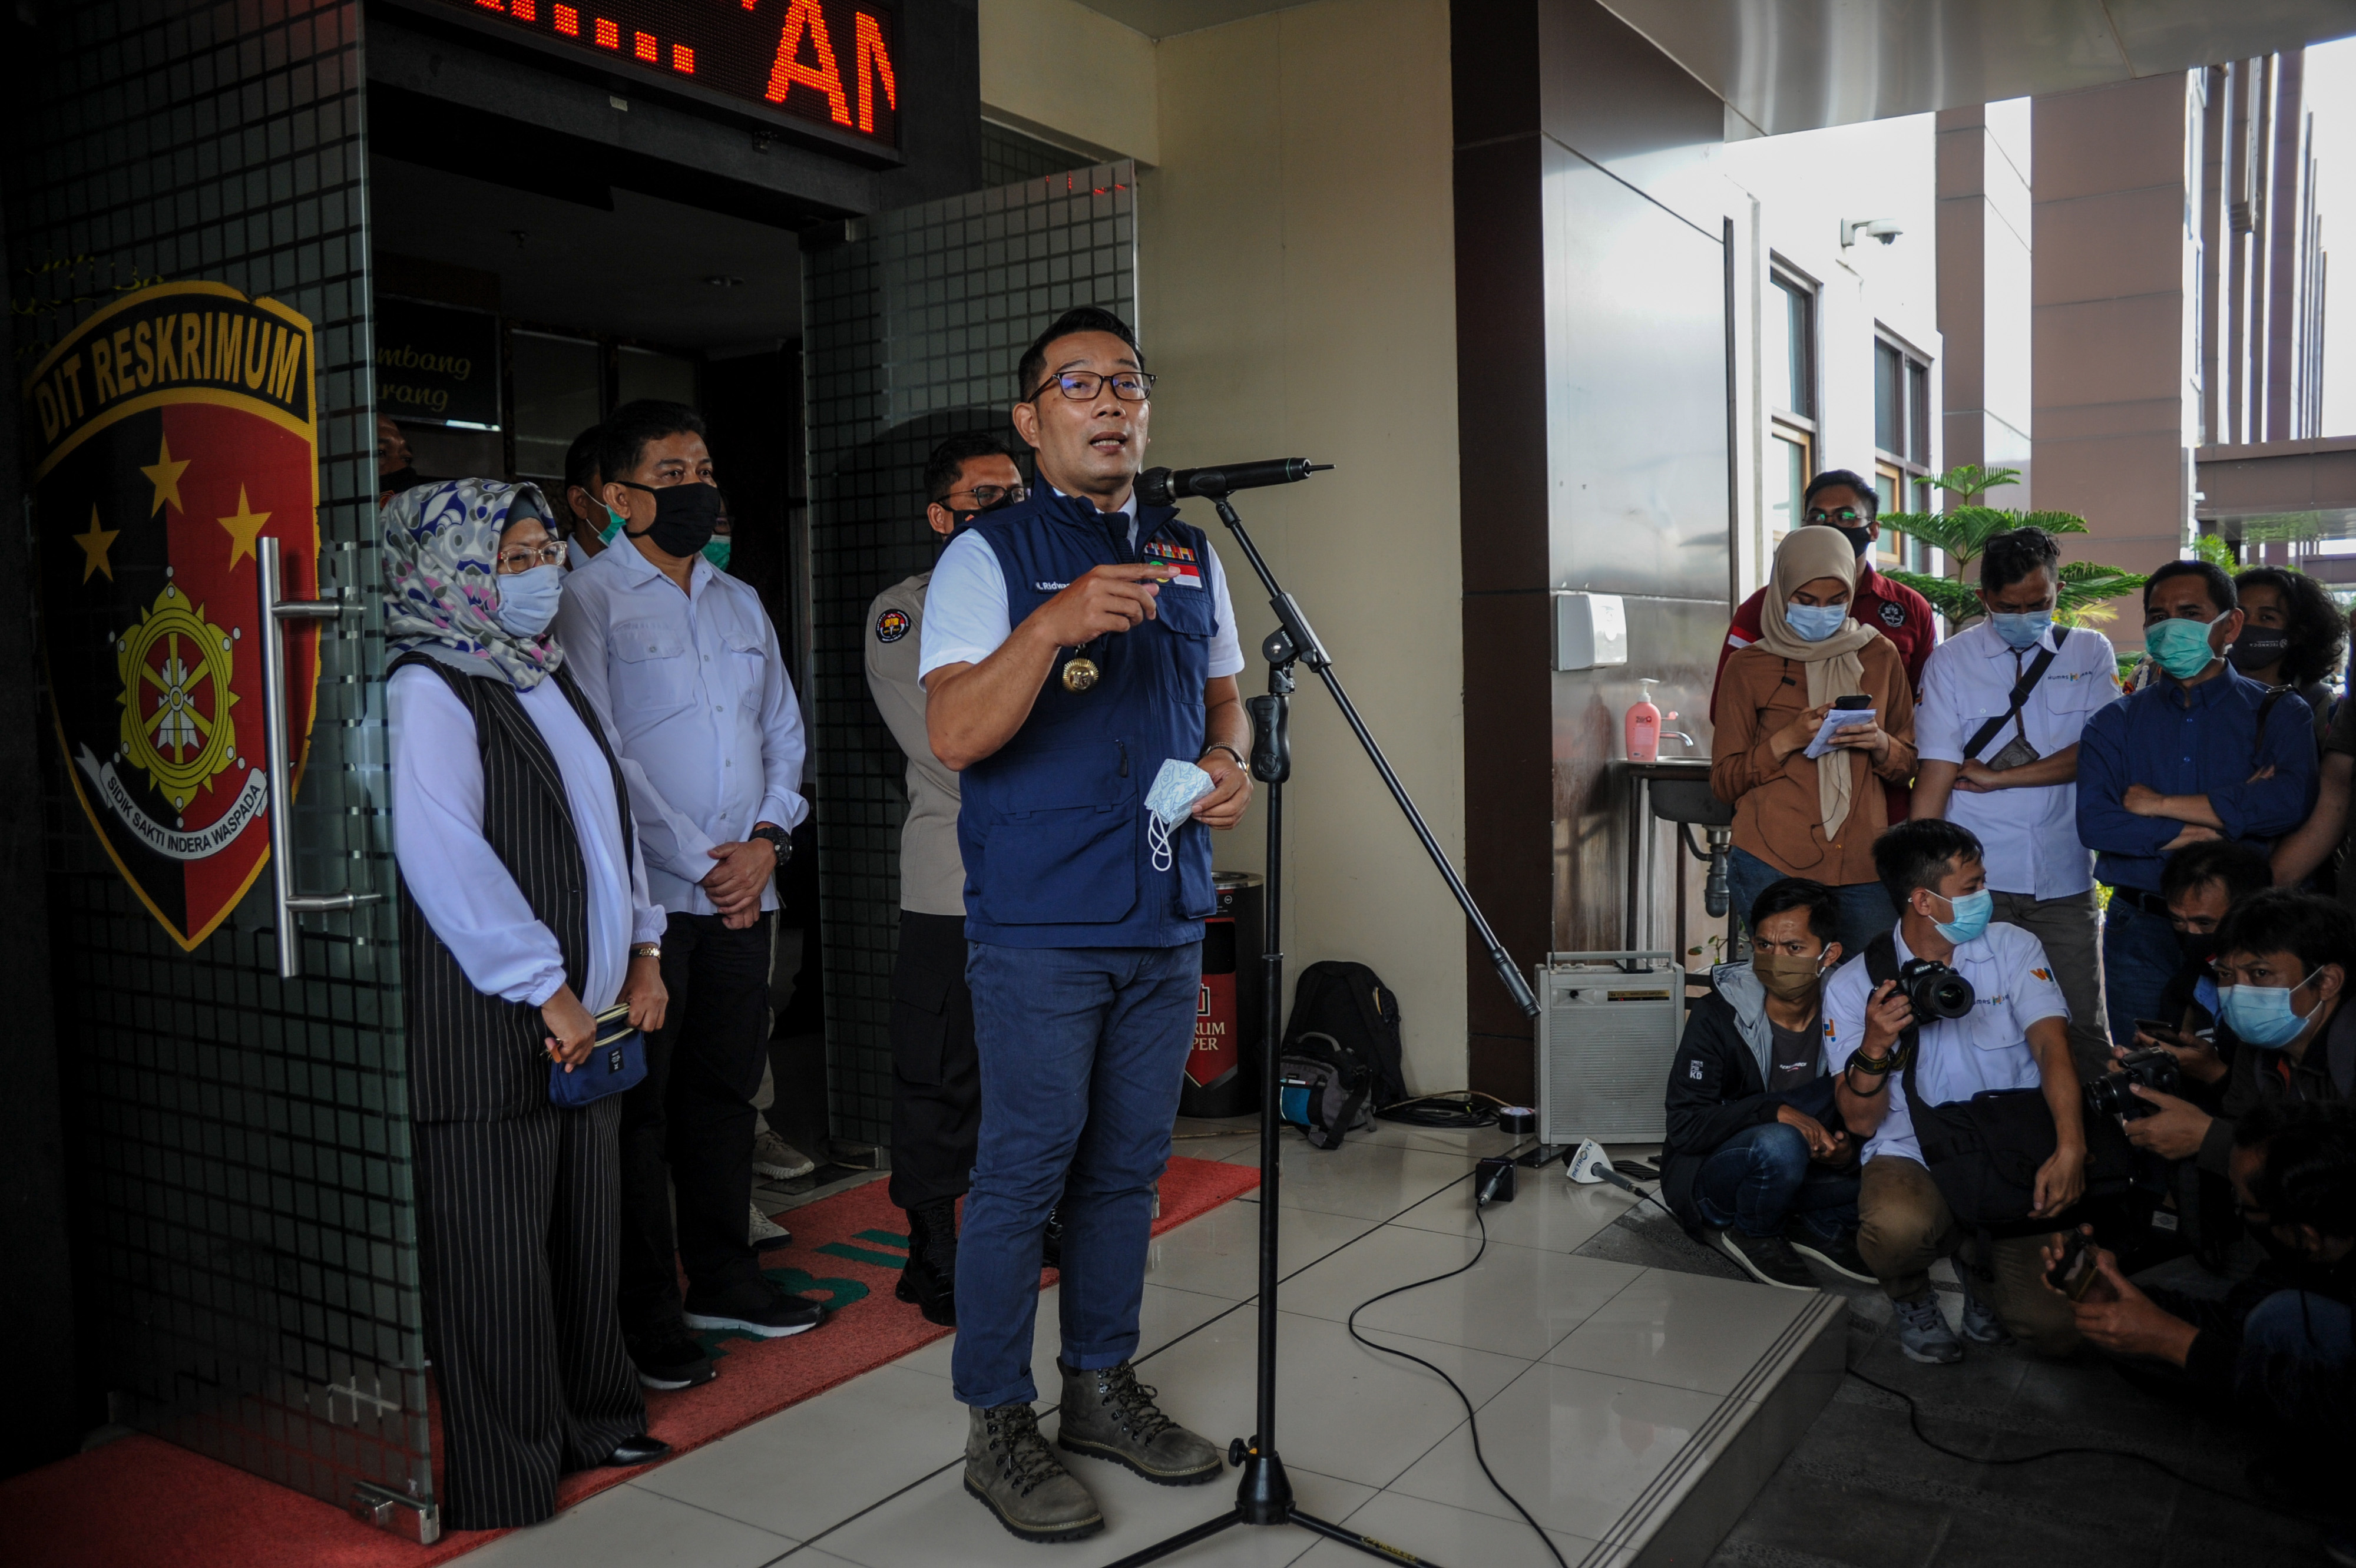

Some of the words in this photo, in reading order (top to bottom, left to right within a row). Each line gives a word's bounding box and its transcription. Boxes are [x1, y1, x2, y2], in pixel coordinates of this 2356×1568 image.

[34, 354, 85, 446] DIT
[91, 311, 303, 405] RESKRIMUM
[108, 776, 134, 818] SIDIK
[132, 812, 165, 846] SAKTI
[167, 835, 213, 853] INDERA
[211, 784, 261, 845] WASPADA
[1585, 1142, 1593, 1150] TV
